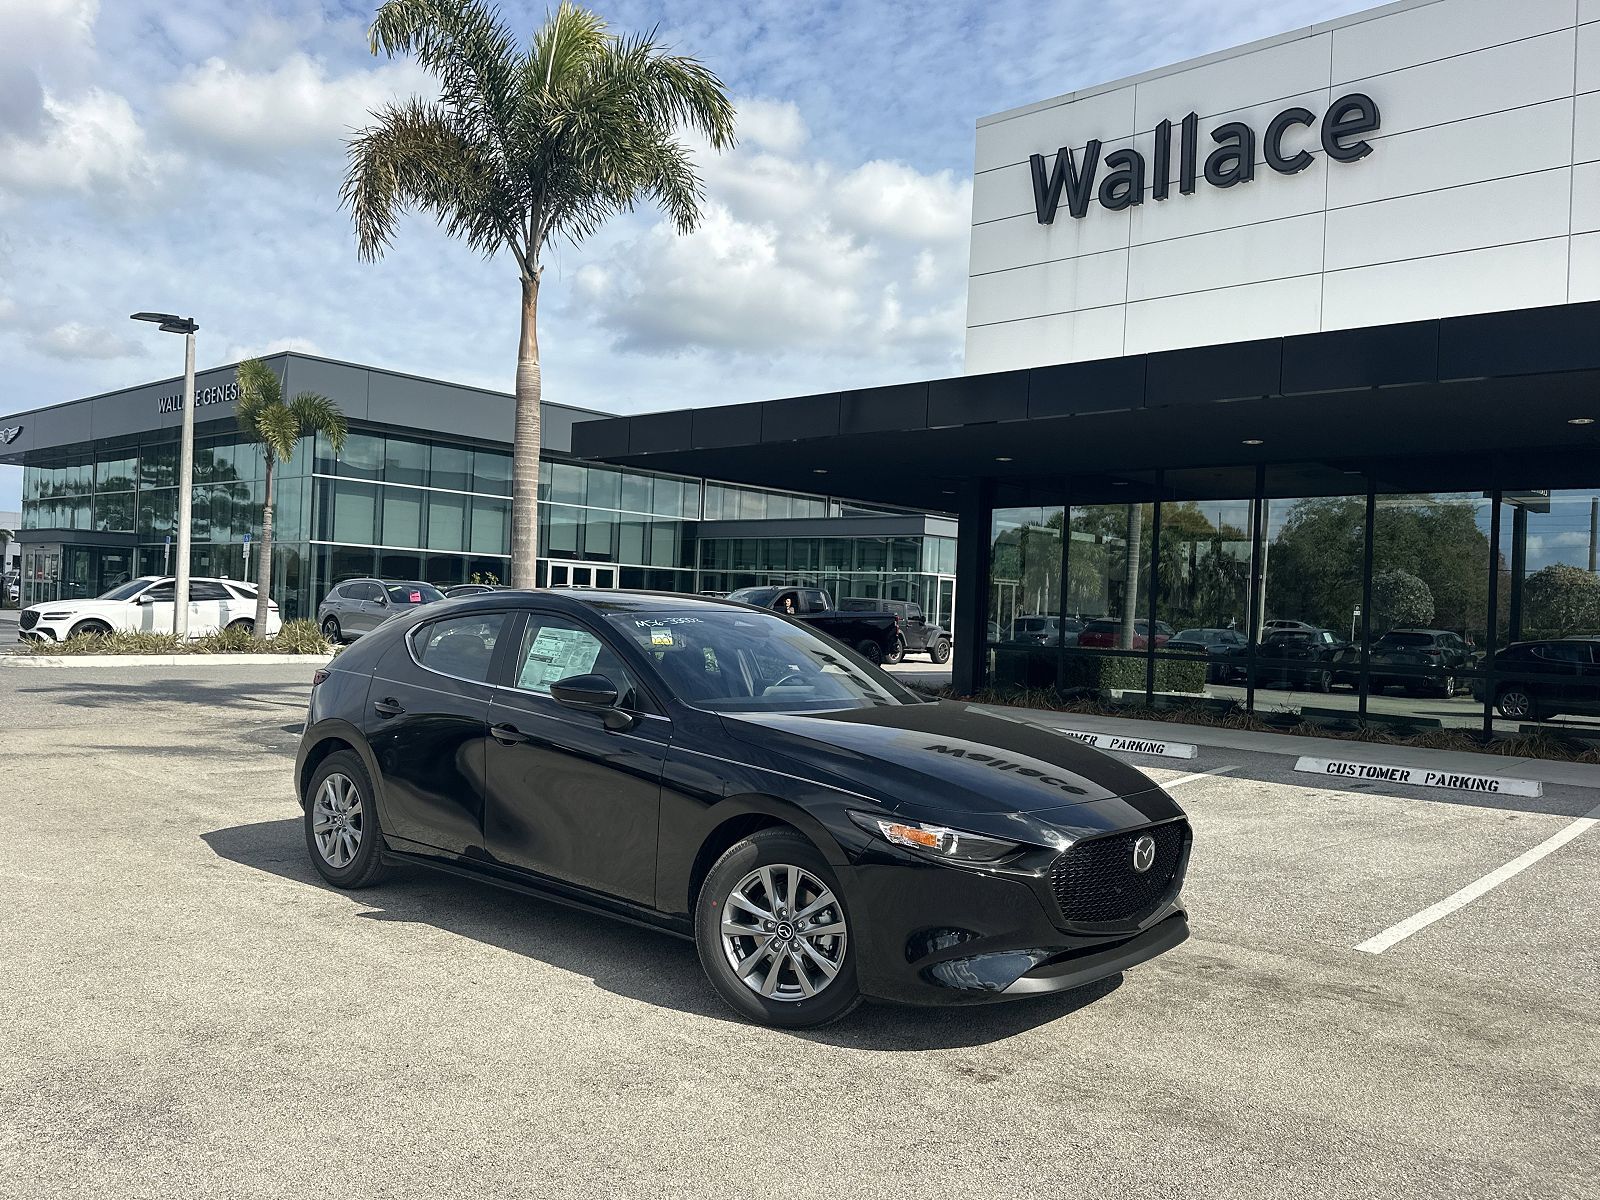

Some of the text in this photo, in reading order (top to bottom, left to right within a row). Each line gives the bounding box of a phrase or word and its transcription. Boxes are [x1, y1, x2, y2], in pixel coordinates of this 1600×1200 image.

[1030, 93, 1381, 225] Wallace
[157, 382, 241, 413] WALLE GENESI
[1109, 738, 1165, 754] PARKING
[1326, 762, 1500, 792] CUSTOMER PARKING
